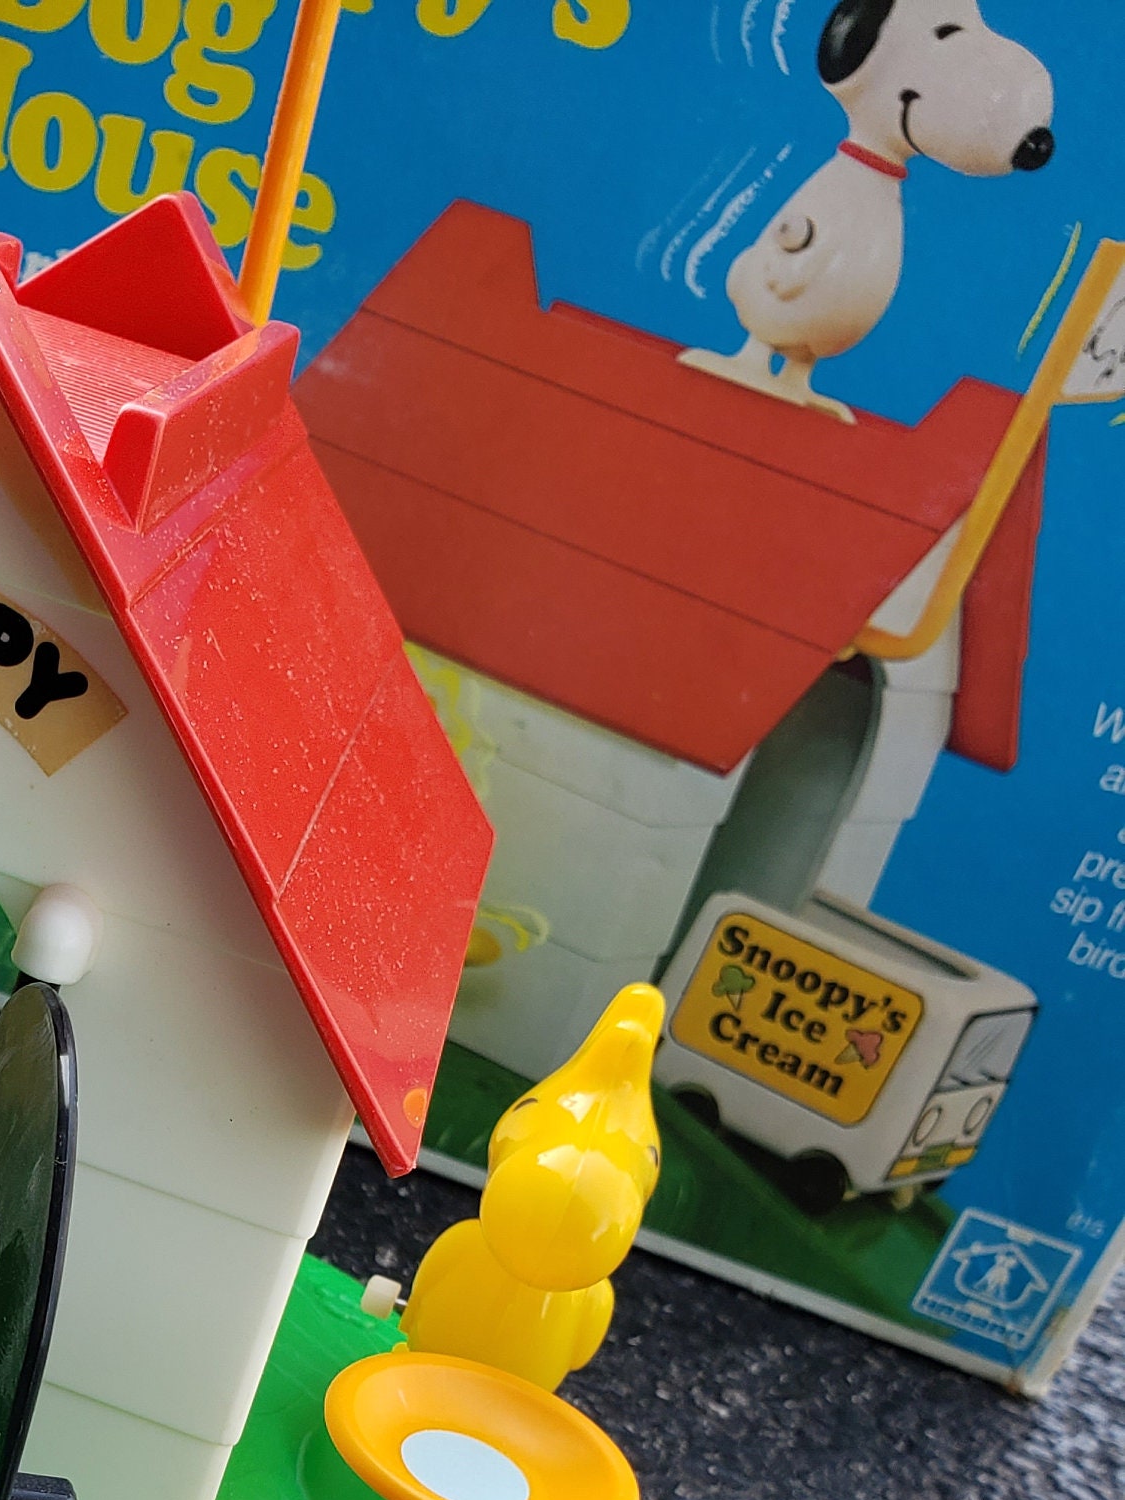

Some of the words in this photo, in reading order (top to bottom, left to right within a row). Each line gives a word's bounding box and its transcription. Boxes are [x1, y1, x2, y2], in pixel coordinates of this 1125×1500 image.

[1049, 885, 1103, 926] sip
[718, 925, 907, 1033] Snoopy's
[762, 990, 827, 1043] Ice
[709, 1011, 844, 1098] Cream
